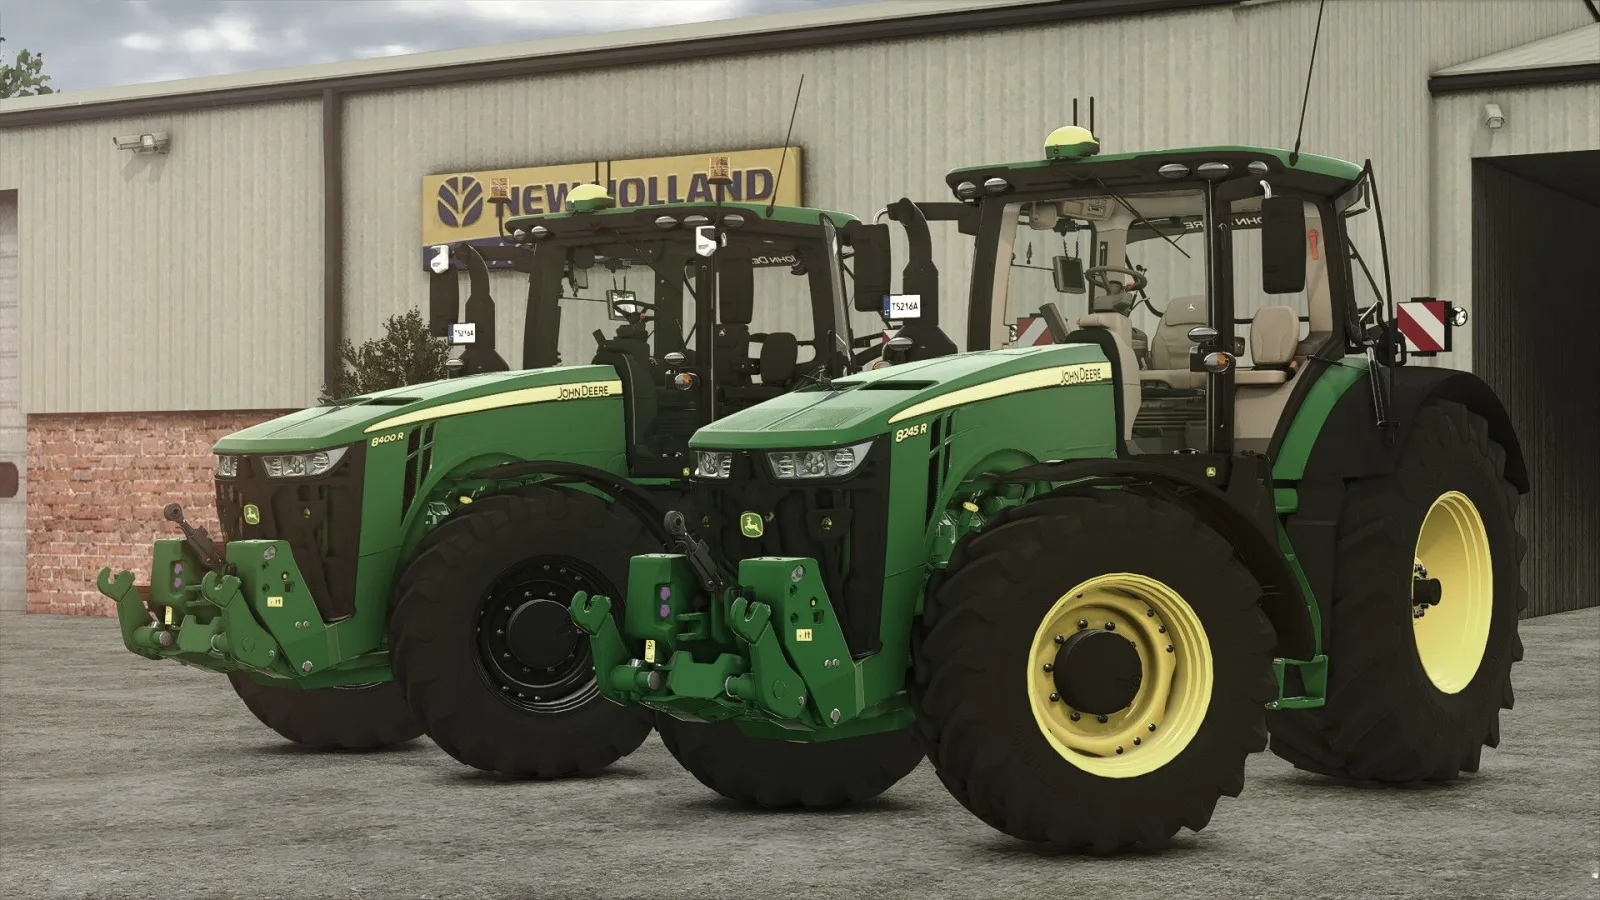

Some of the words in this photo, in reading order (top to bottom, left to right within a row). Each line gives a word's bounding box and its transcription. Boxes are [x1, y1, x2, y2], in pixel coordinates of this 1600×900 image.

[496, 182, 581, 217] NEW
[1060, 369, 1080, 384] JOHN
[1080, 367, 1102, 381] DEERE
[557, 386, 581, 399] JOHN
[581, 385, 609, 397] DEERE
[371, 433, 397, 447] 8400
[397, 431, 405, 441] R
[895, 424, 920, 443] 8245
[920, 422, 928, 435] R
